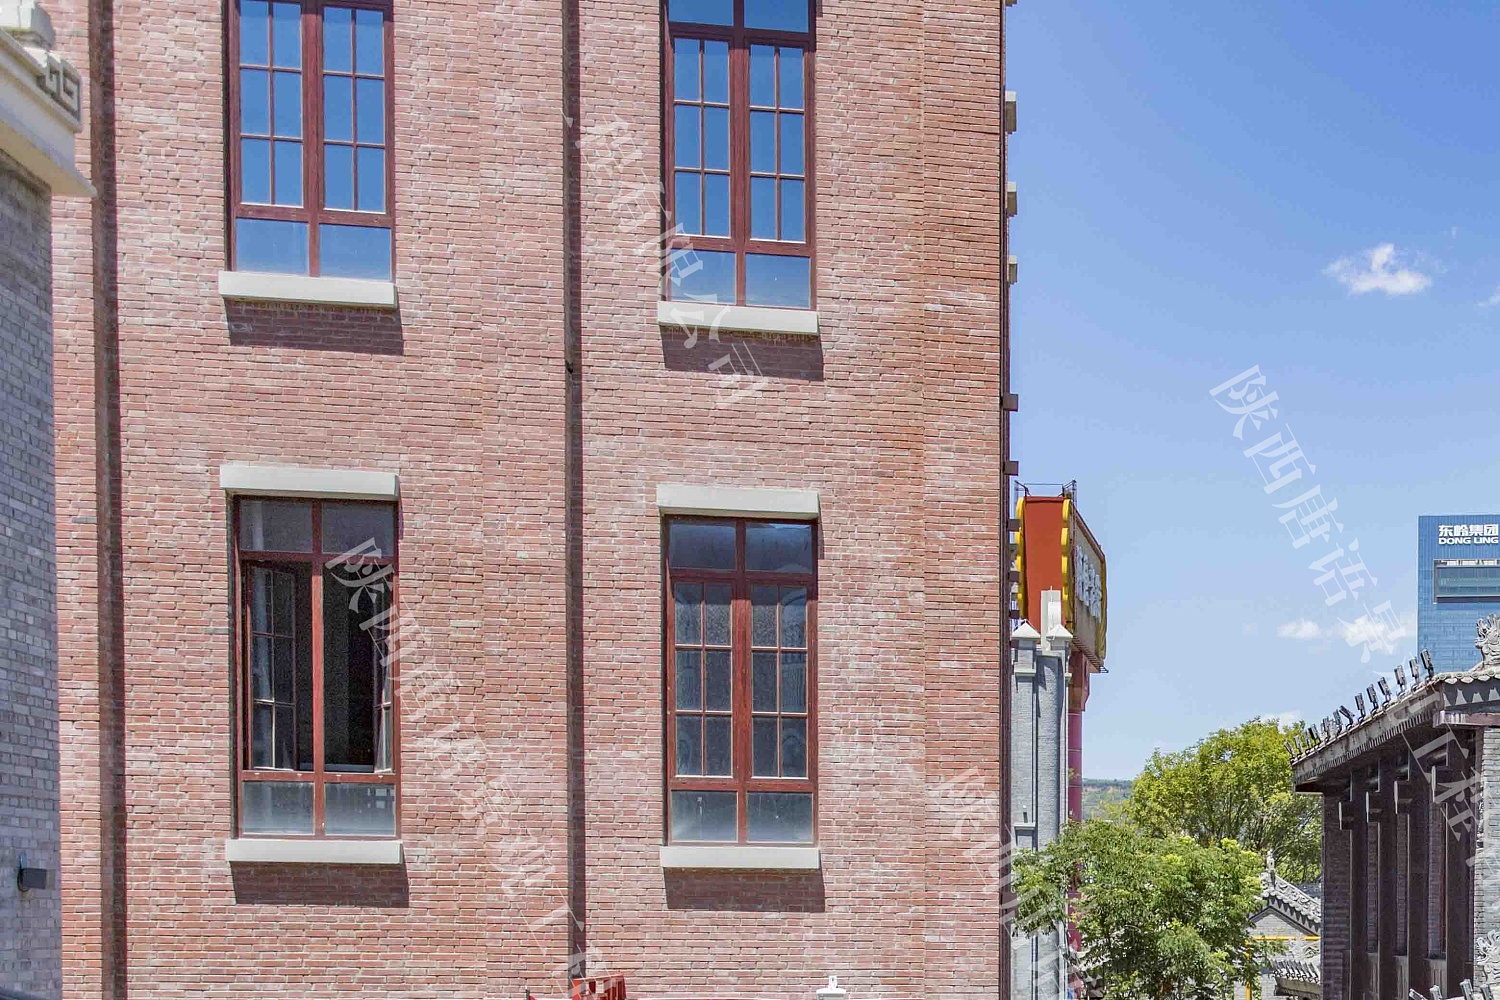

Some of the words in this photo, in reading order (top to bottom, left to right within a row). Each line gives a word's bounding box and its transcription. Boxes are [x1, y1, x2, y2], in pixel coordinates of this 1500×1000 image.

[1438, 524, 1499, 537] 东岭集团
[1438, 537, 1472, 545] DONG
[1473, 536, 1499, 544] LING
